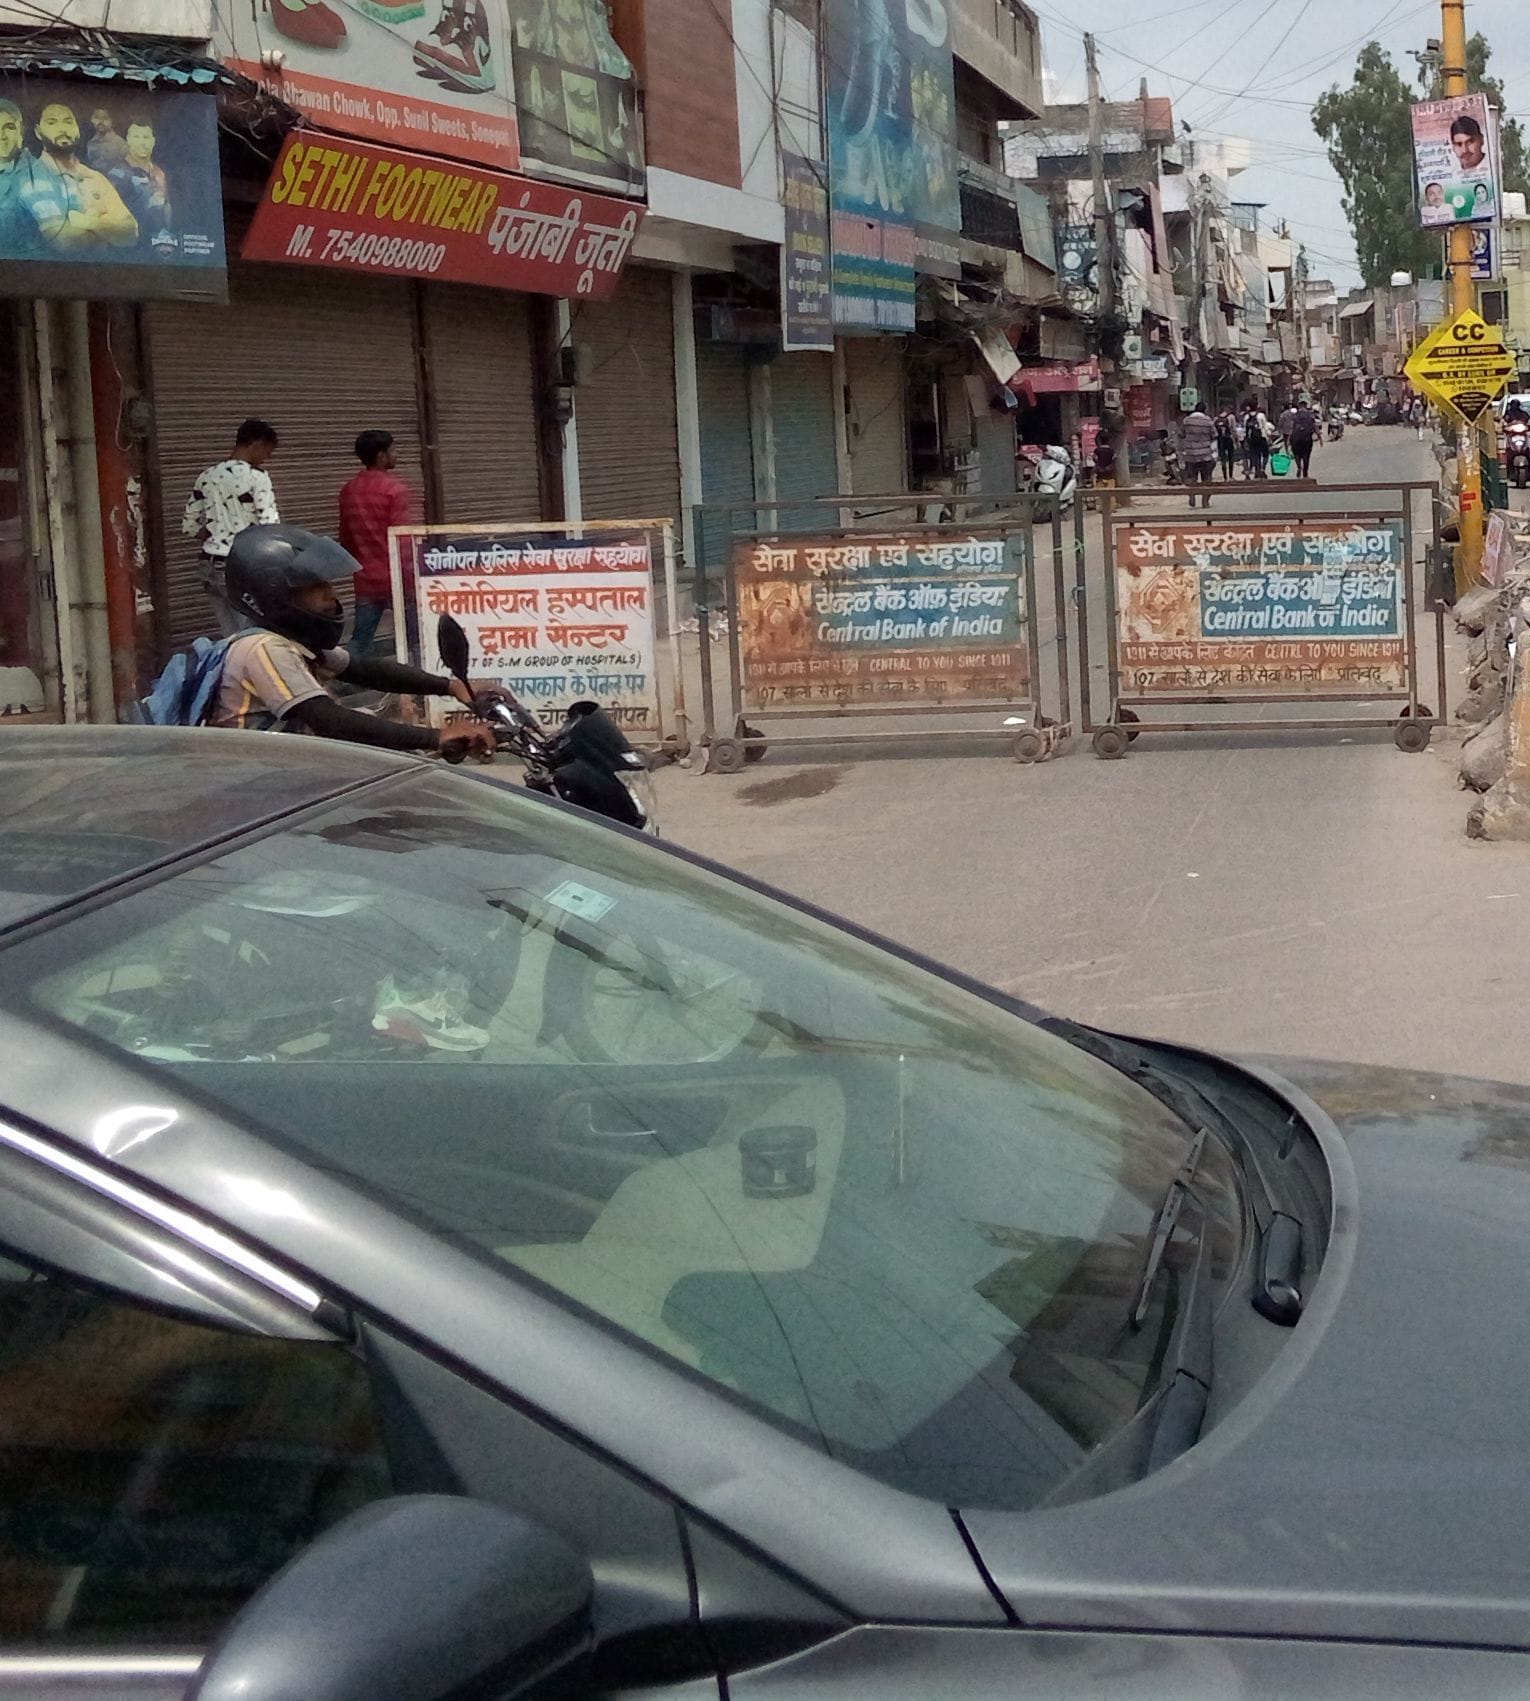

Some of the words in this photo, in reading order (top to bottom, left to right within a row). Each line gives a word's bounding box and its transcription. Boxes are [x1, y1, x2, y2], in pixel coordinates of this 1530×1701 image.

[333, 92, 375, 123] Chowk,
[377, 100, 401, 129] Opp.
[403, 106, 429, 132] Sunil
[432, 113, 469, 139] Sweets,
[271, 142, 368, 215] SETHI
[358, 160, 498, 235] FOOTWEAR
[286, 224, 314, 258] M.
[319, 229, 446, 273] 7540988000
[487, 191, 582, 264] पंजाबी
[574, 210, 637, 293] जूती
[1452, 323, 1485, 341] CC
[804, 545, 872, 577] सुरक्षा
[876, 539, 910, 567] एवं
[915, 536, 1005, 570] सहयोग
[1130, 529, 1176, 557] सेवा
[1260, 526, 1294, 554] एवं
[424, 545, 479, 572] सोनीपत
[480, 543, 521, 574] पुलिस
[522, 542, 553, 568] सेवा
[553, 547, 592, 571] सुरक्षा
[593, 542, 647, 571] सहयोग
[874, 585, 907, 611] बैंक
[1266, 572, 1300, 600] बैंक
[818, 620, 880, 642] Central
[881, 617, 927, 640] Bank
[928, 616, 949, 637] of
[951, 614, 1004, 636] India
[1205, 605, 1271, 631] Central
[1271, 604, 1316, 629] Bank
[1340, 604, 1390, 627] India
[545, 618, 629, 653] सेन्टर
[1307, 643, 1320, 658] TO
[1323, 643, 1345, 658] YOU
[1349, 642, 1378, 657] SINCE
[482, 657, 493, 667] OF
[525, 655, 559, 667] GROUP
[561, 655, 573, 666] OF
[870, 657, 912, 672] CENTRAL
[917, 656, 931, 669] TO
[958, 655, 986, 668] SINCE
[509, 676, 566, 700] सरकार
[568, 669, 586, 697] के
[624, 674, 646, 697] पर
